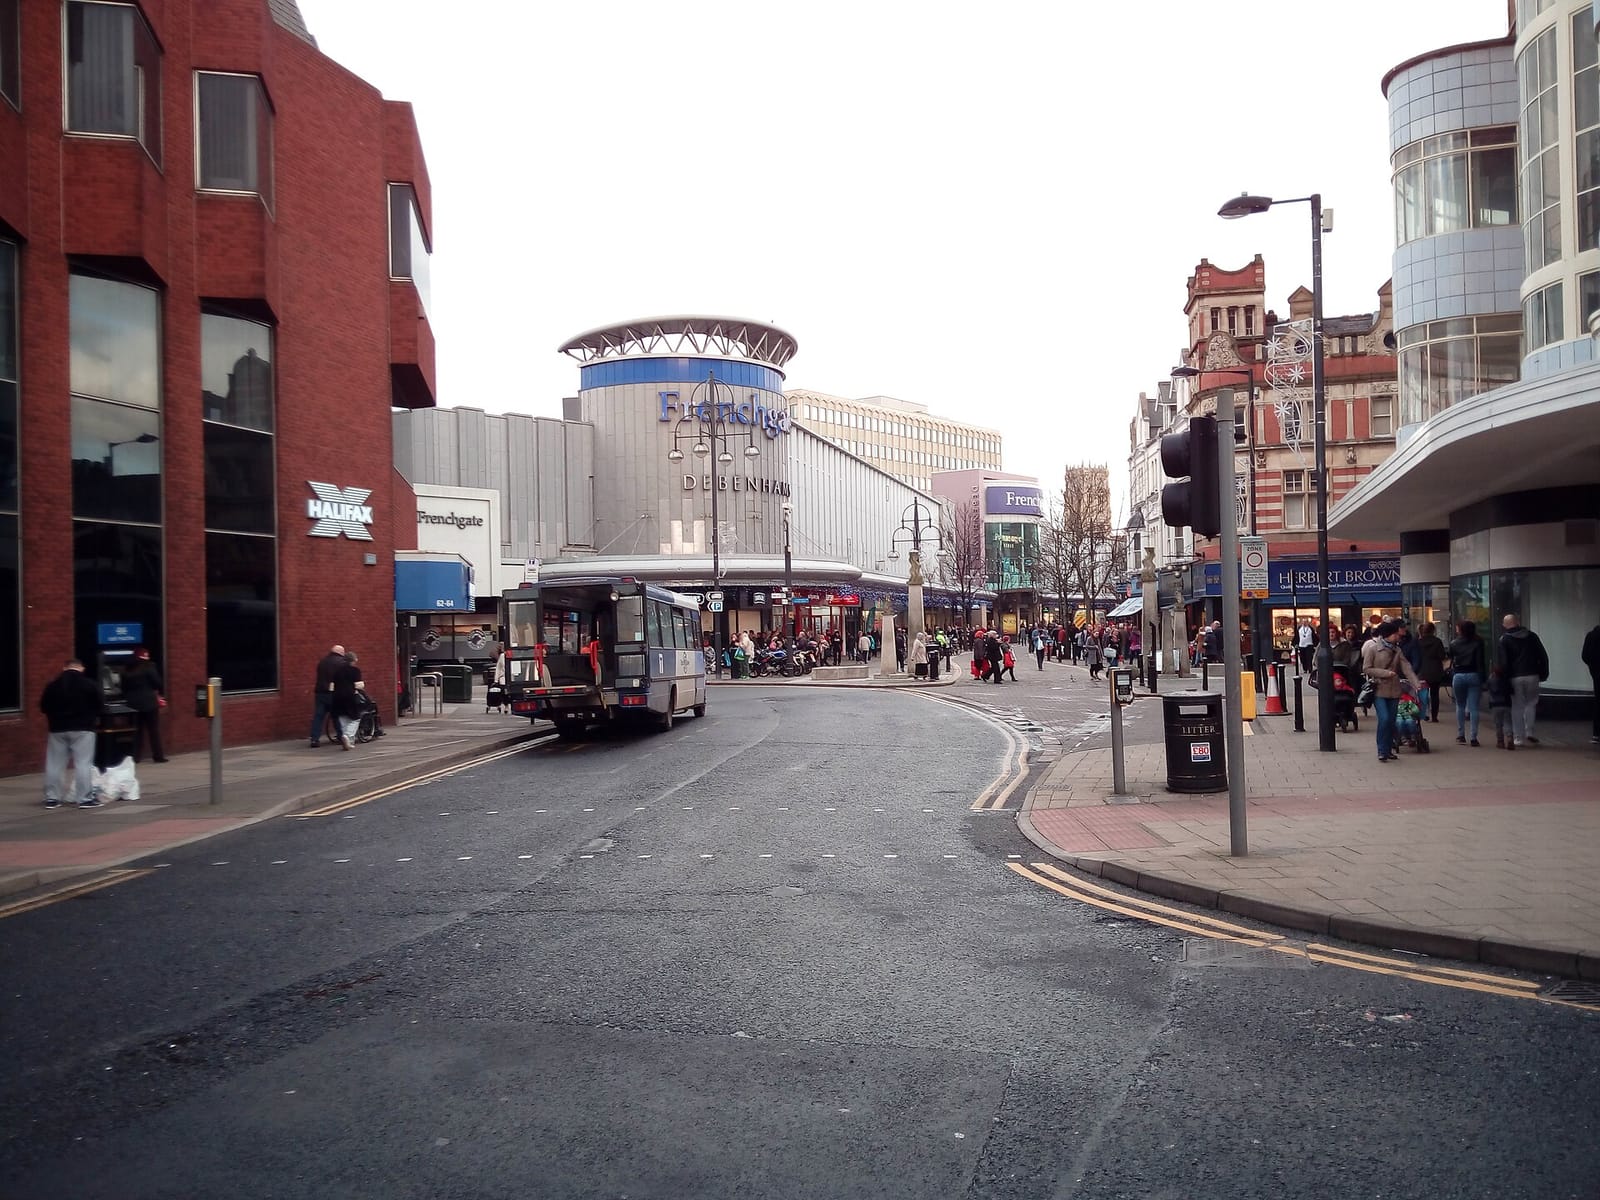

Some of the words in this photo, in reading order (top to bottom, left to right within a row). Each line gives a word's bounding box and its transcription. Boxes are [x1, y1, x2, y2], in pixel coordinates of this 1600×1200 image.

[307, 499, 374, 526] HALIFAX
[416, 510, 484, 530] Frenchgate
[1279, 570, 1341, 584] HRBRT
[1182, 726, 1216, 734] LITTER
